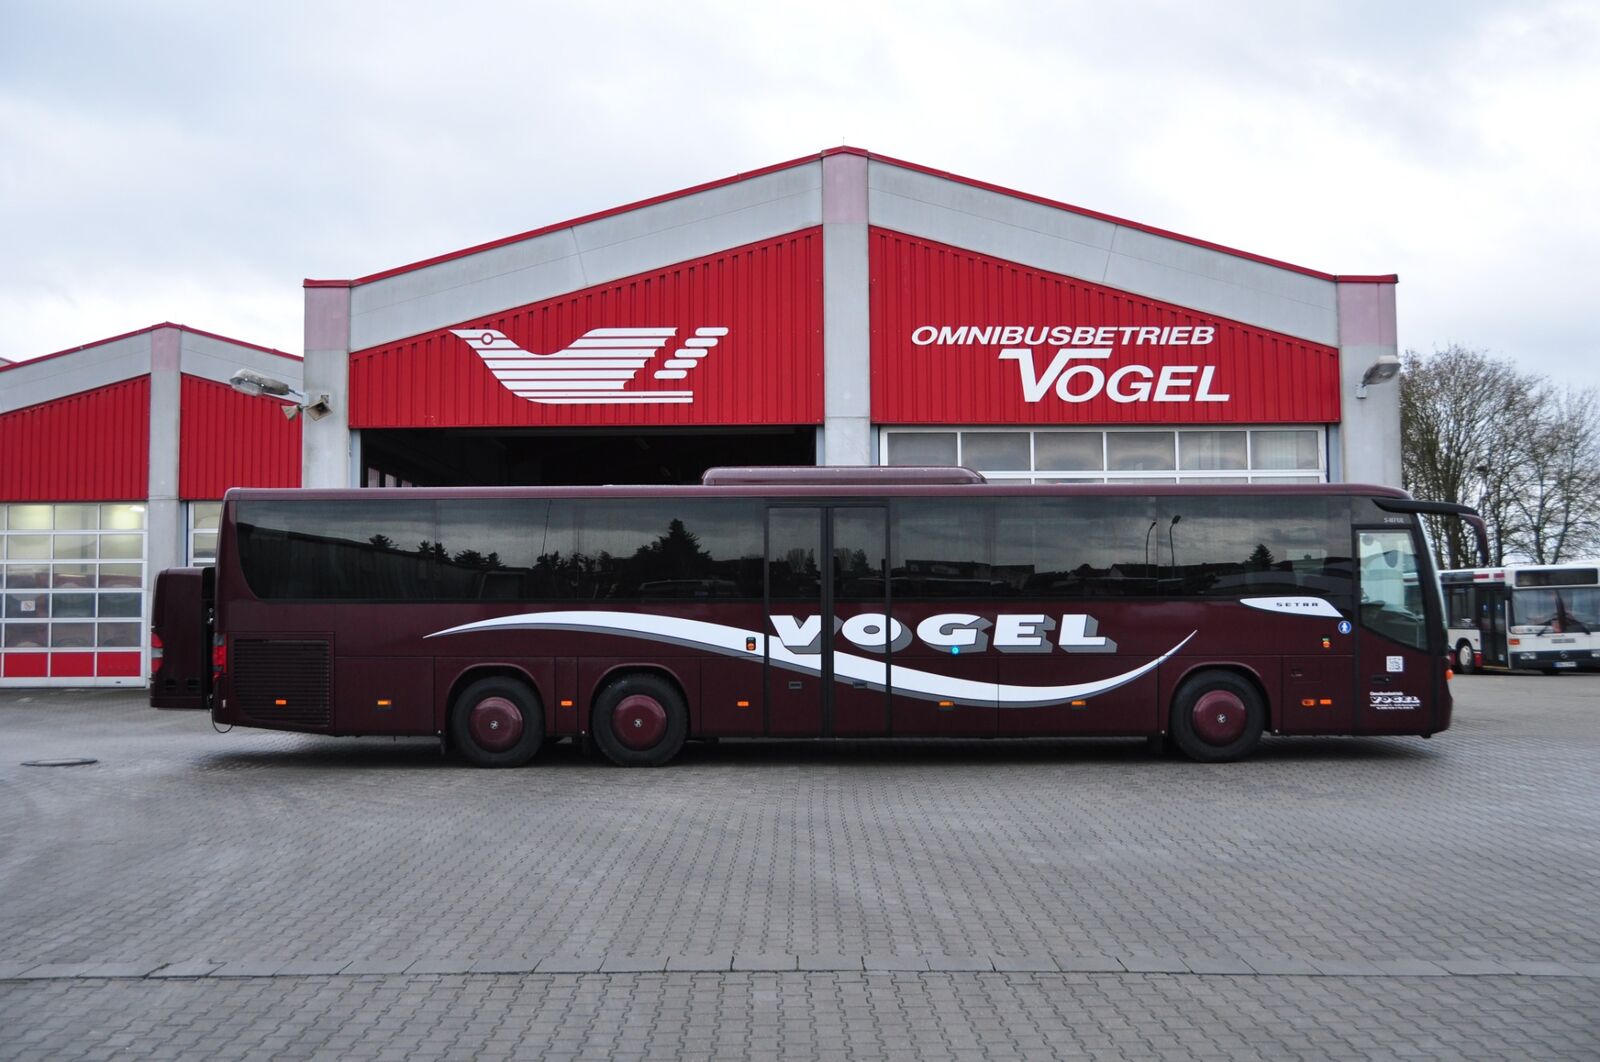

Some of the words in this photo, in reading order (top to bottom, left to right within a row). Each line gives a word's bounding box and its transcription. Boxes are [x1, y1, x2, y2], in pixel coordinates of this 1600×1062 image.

[911, 325, 1215, 346] OMNIBUSBETRIEB
[998, 348, 1230, 403] VOGEL
[769, 613, 1118, 654] VOGEL
